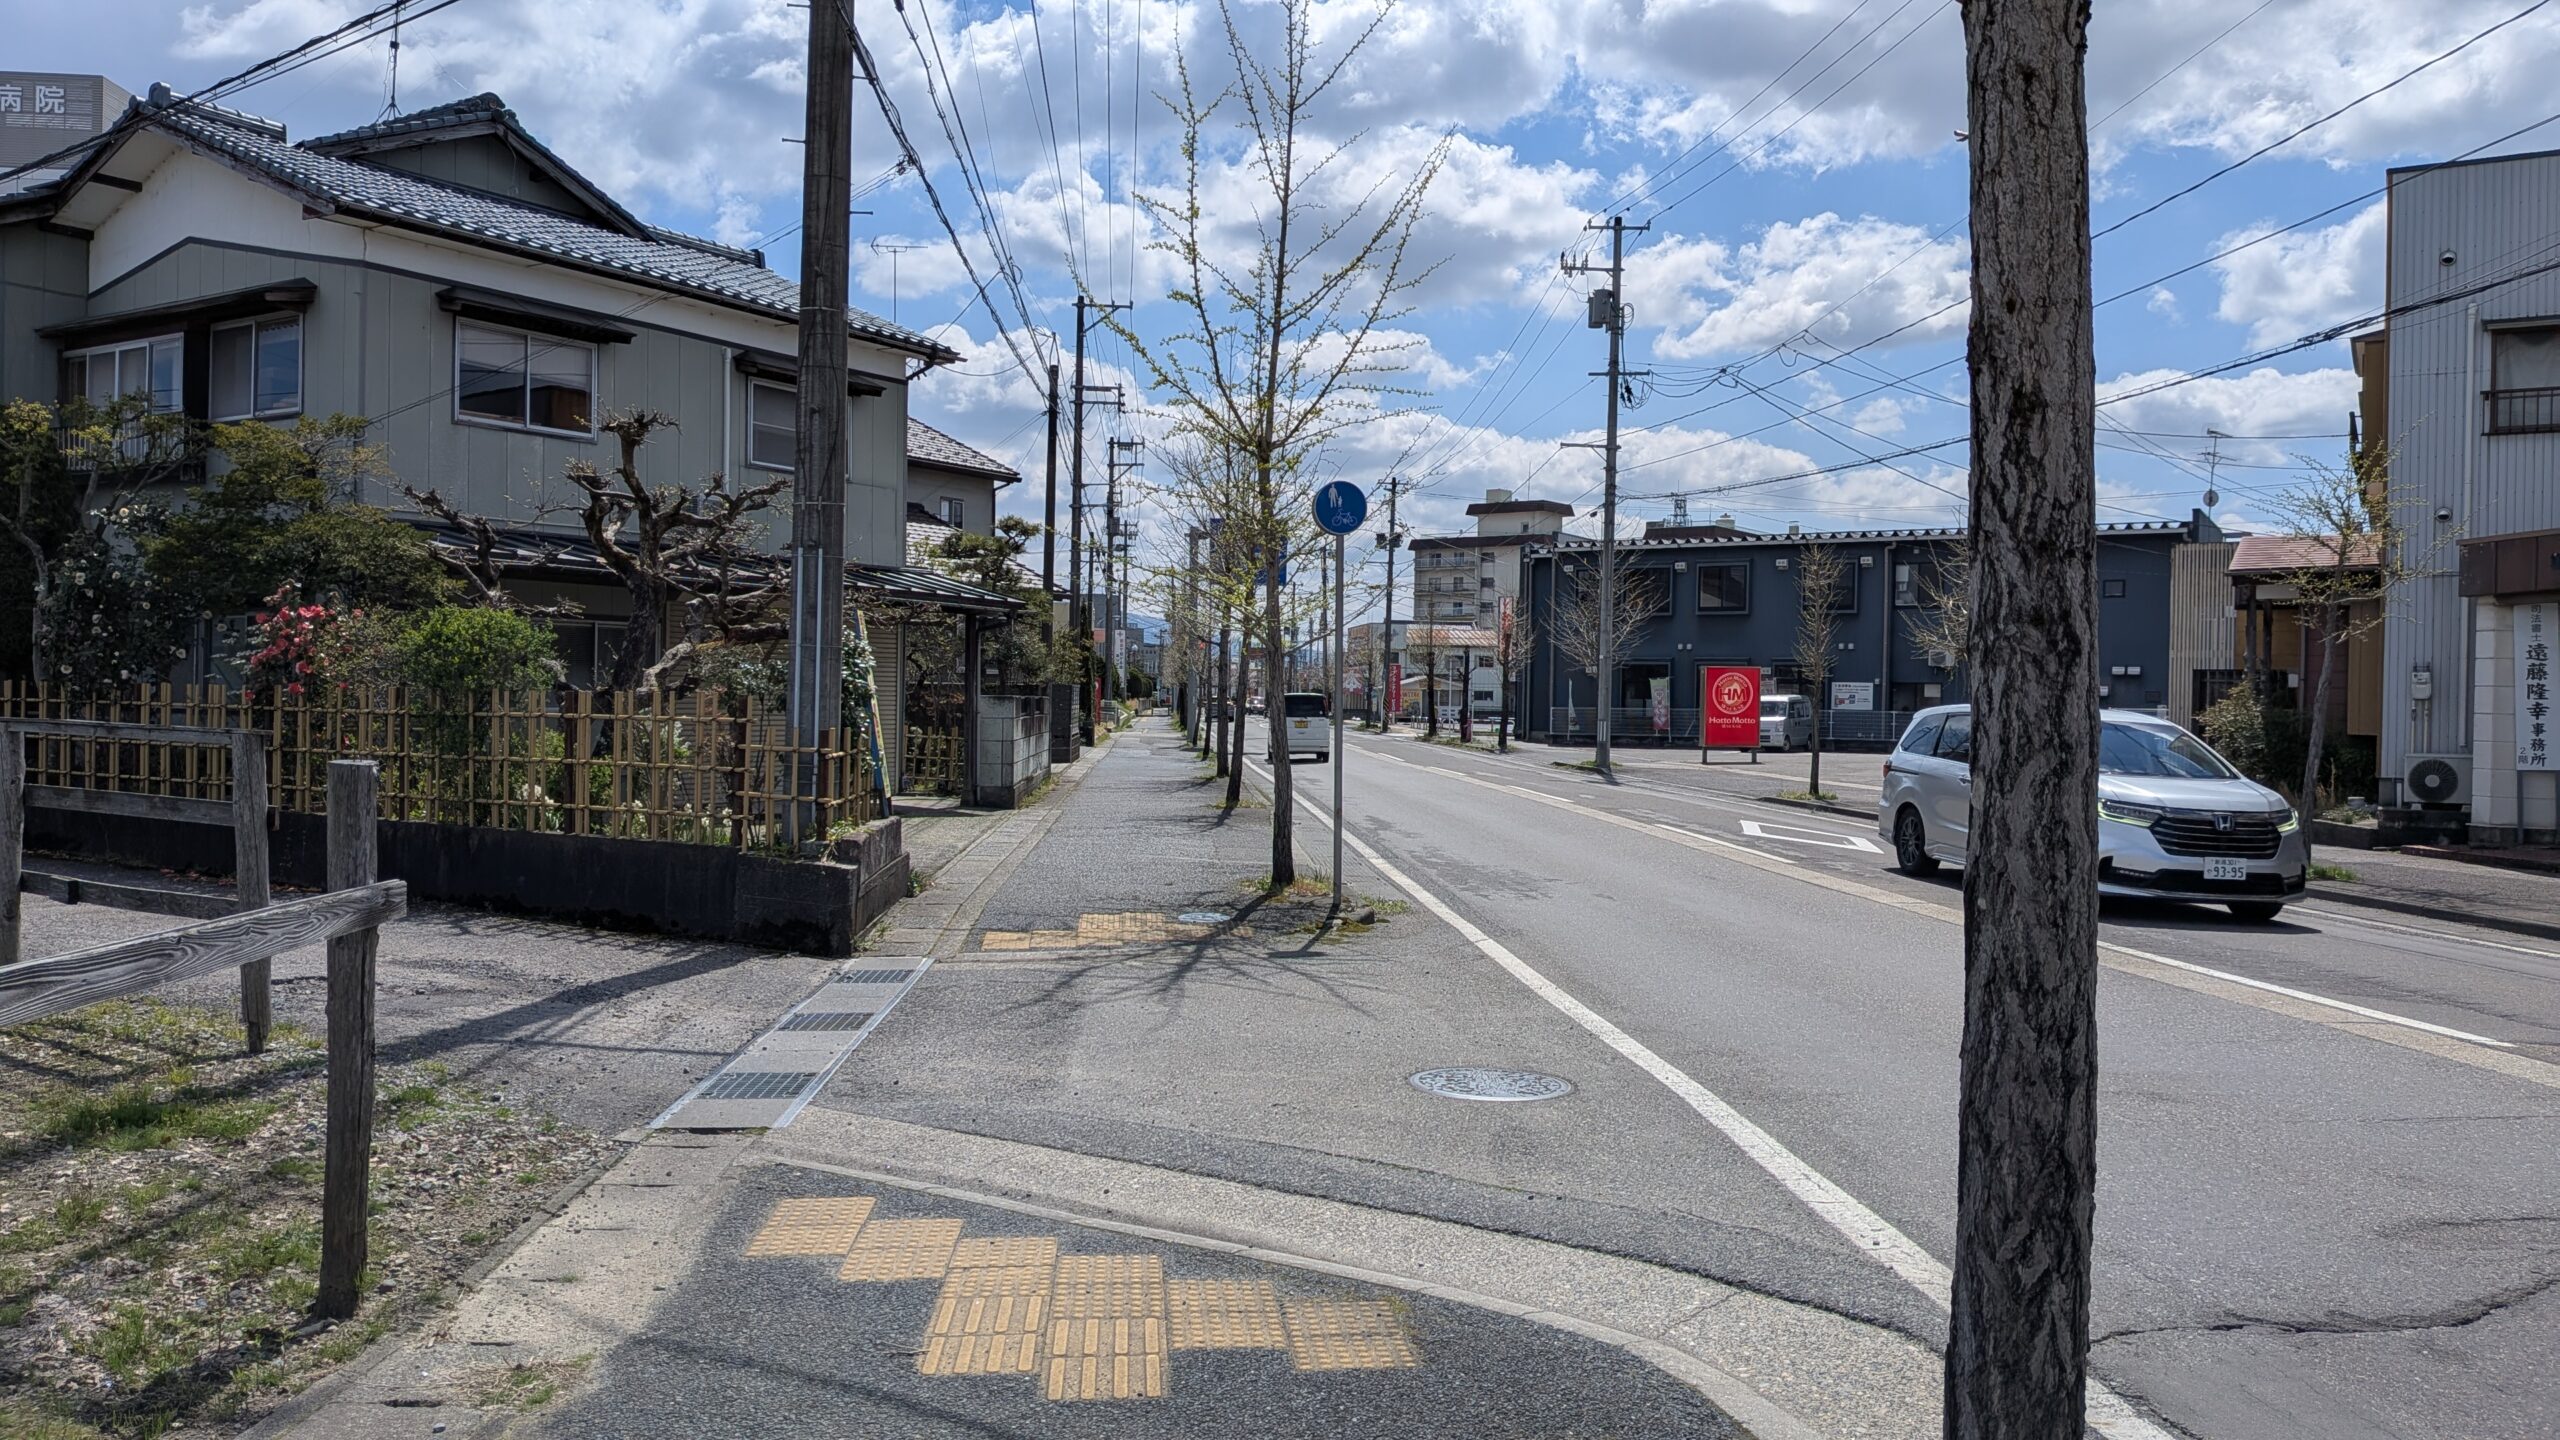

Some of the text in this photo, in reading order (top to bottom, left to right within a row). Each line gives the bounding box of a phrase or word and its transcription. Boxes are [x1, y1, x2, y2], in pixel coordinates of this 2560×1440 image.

[0, 84, 65, 114] 病院
[1719, 688, 1747, 701] HM
[2213, 866, 2244, 879] 93-95
